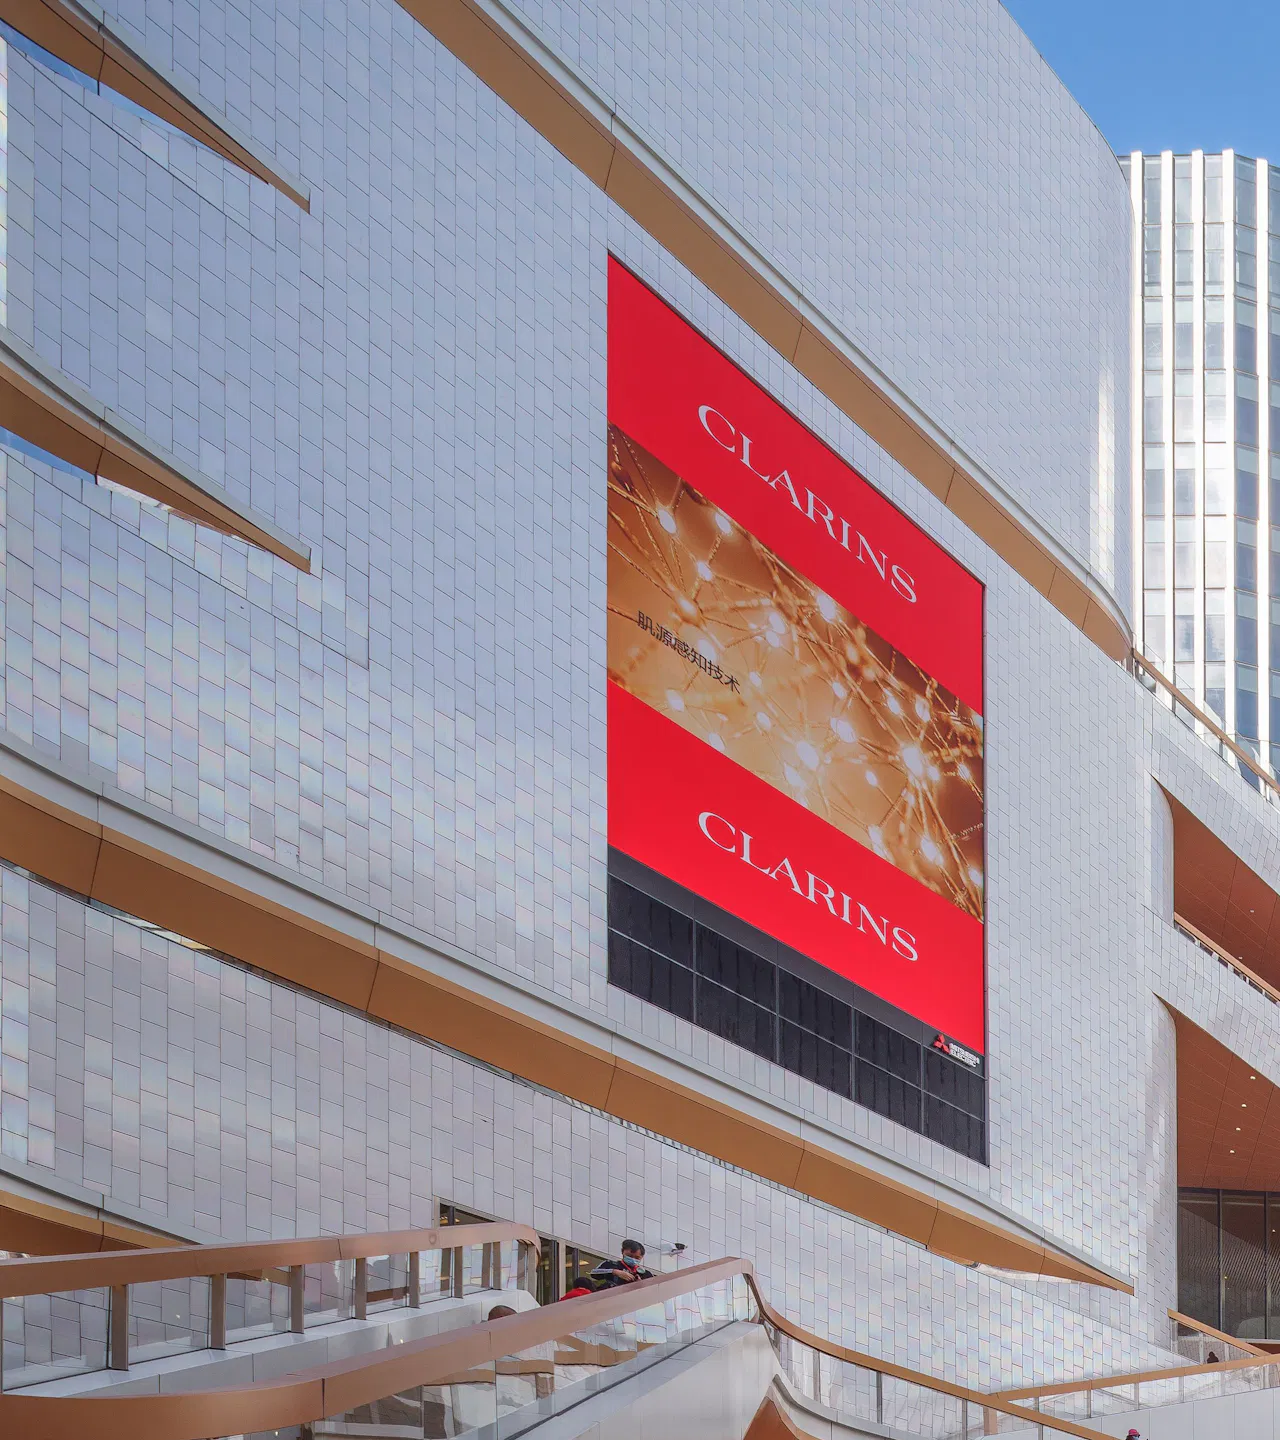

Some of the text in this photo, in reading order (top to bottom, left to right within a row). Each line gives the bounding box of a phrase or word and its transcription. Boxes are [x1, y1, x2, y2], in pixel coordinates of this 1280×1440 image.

[697, 404, 918, 604] CLARINS
[637, 609, 741, 695] 肌源感知技术
[697, 811, 918, 962] CLARINS
